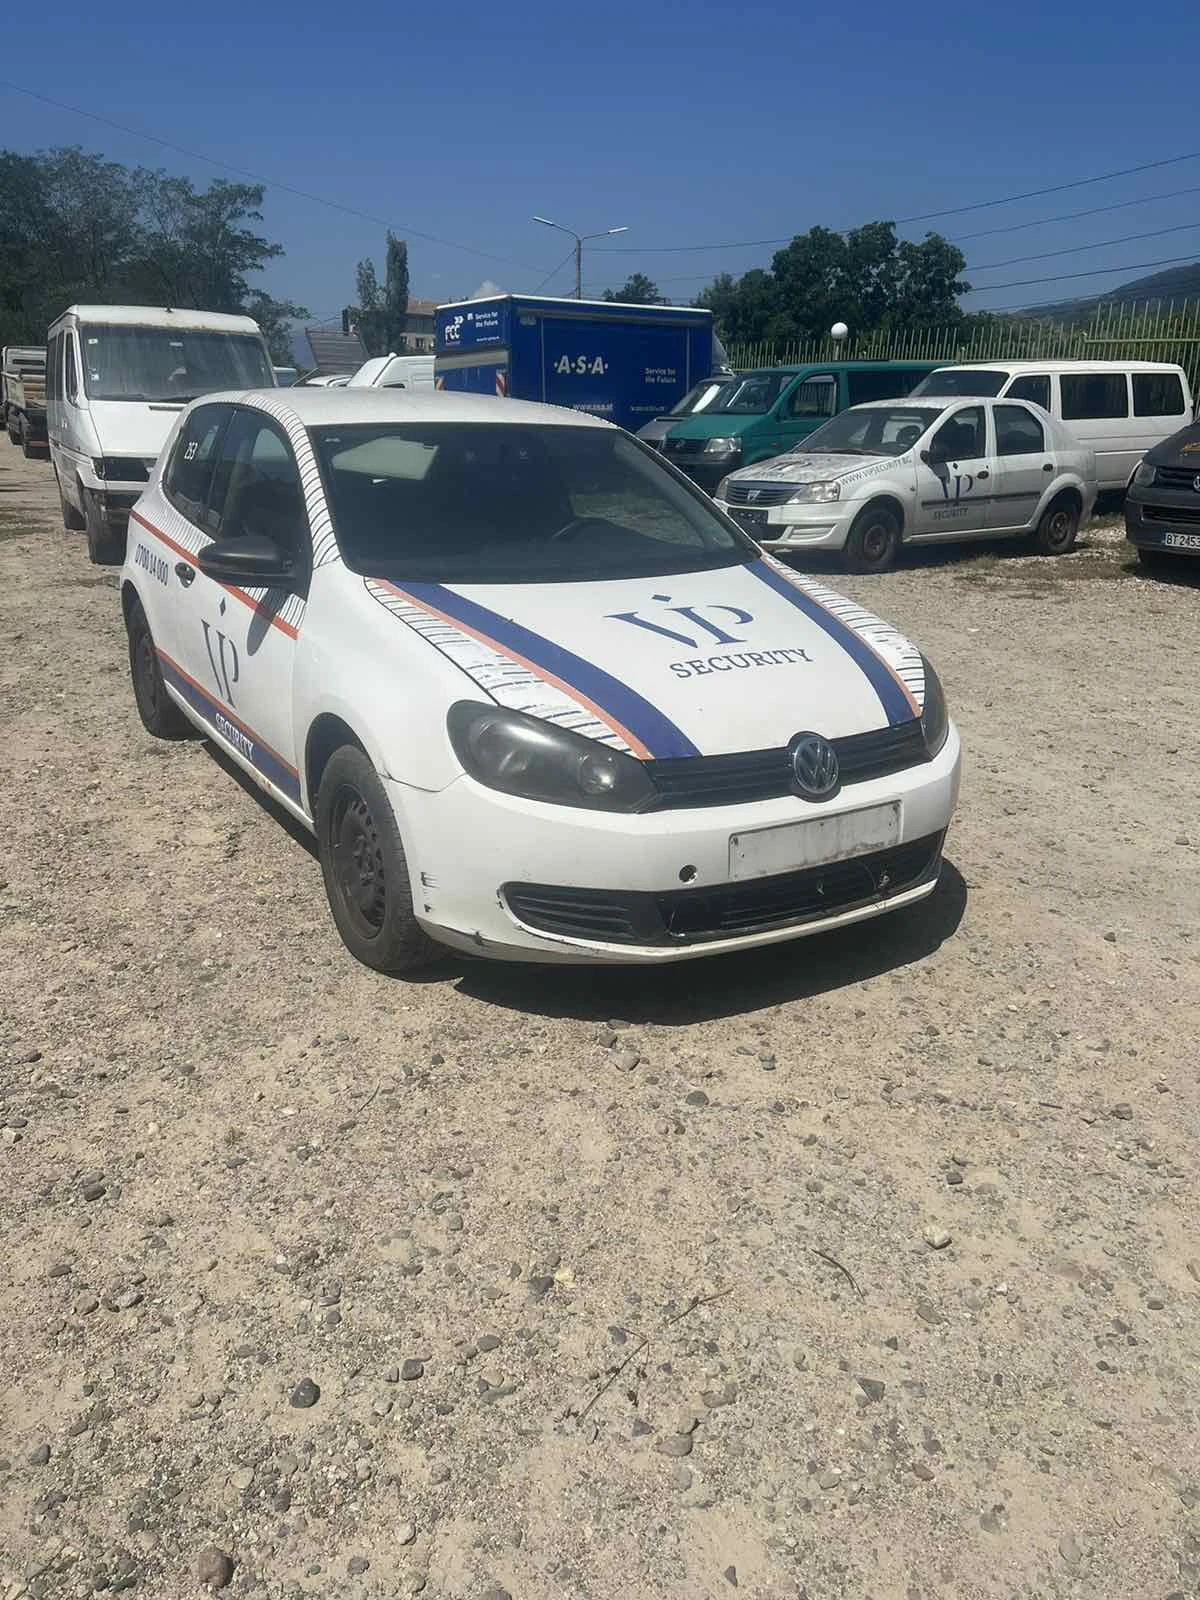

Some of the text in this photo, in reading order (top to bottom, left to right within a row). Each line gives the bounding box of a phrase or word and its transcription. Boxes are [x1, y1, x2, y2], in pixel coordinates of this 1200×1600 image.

[445, 324, 461, 340] FCC
[669, 648, 813, 679] SECURITY
[215, 712, 255, 761] SECURITY
